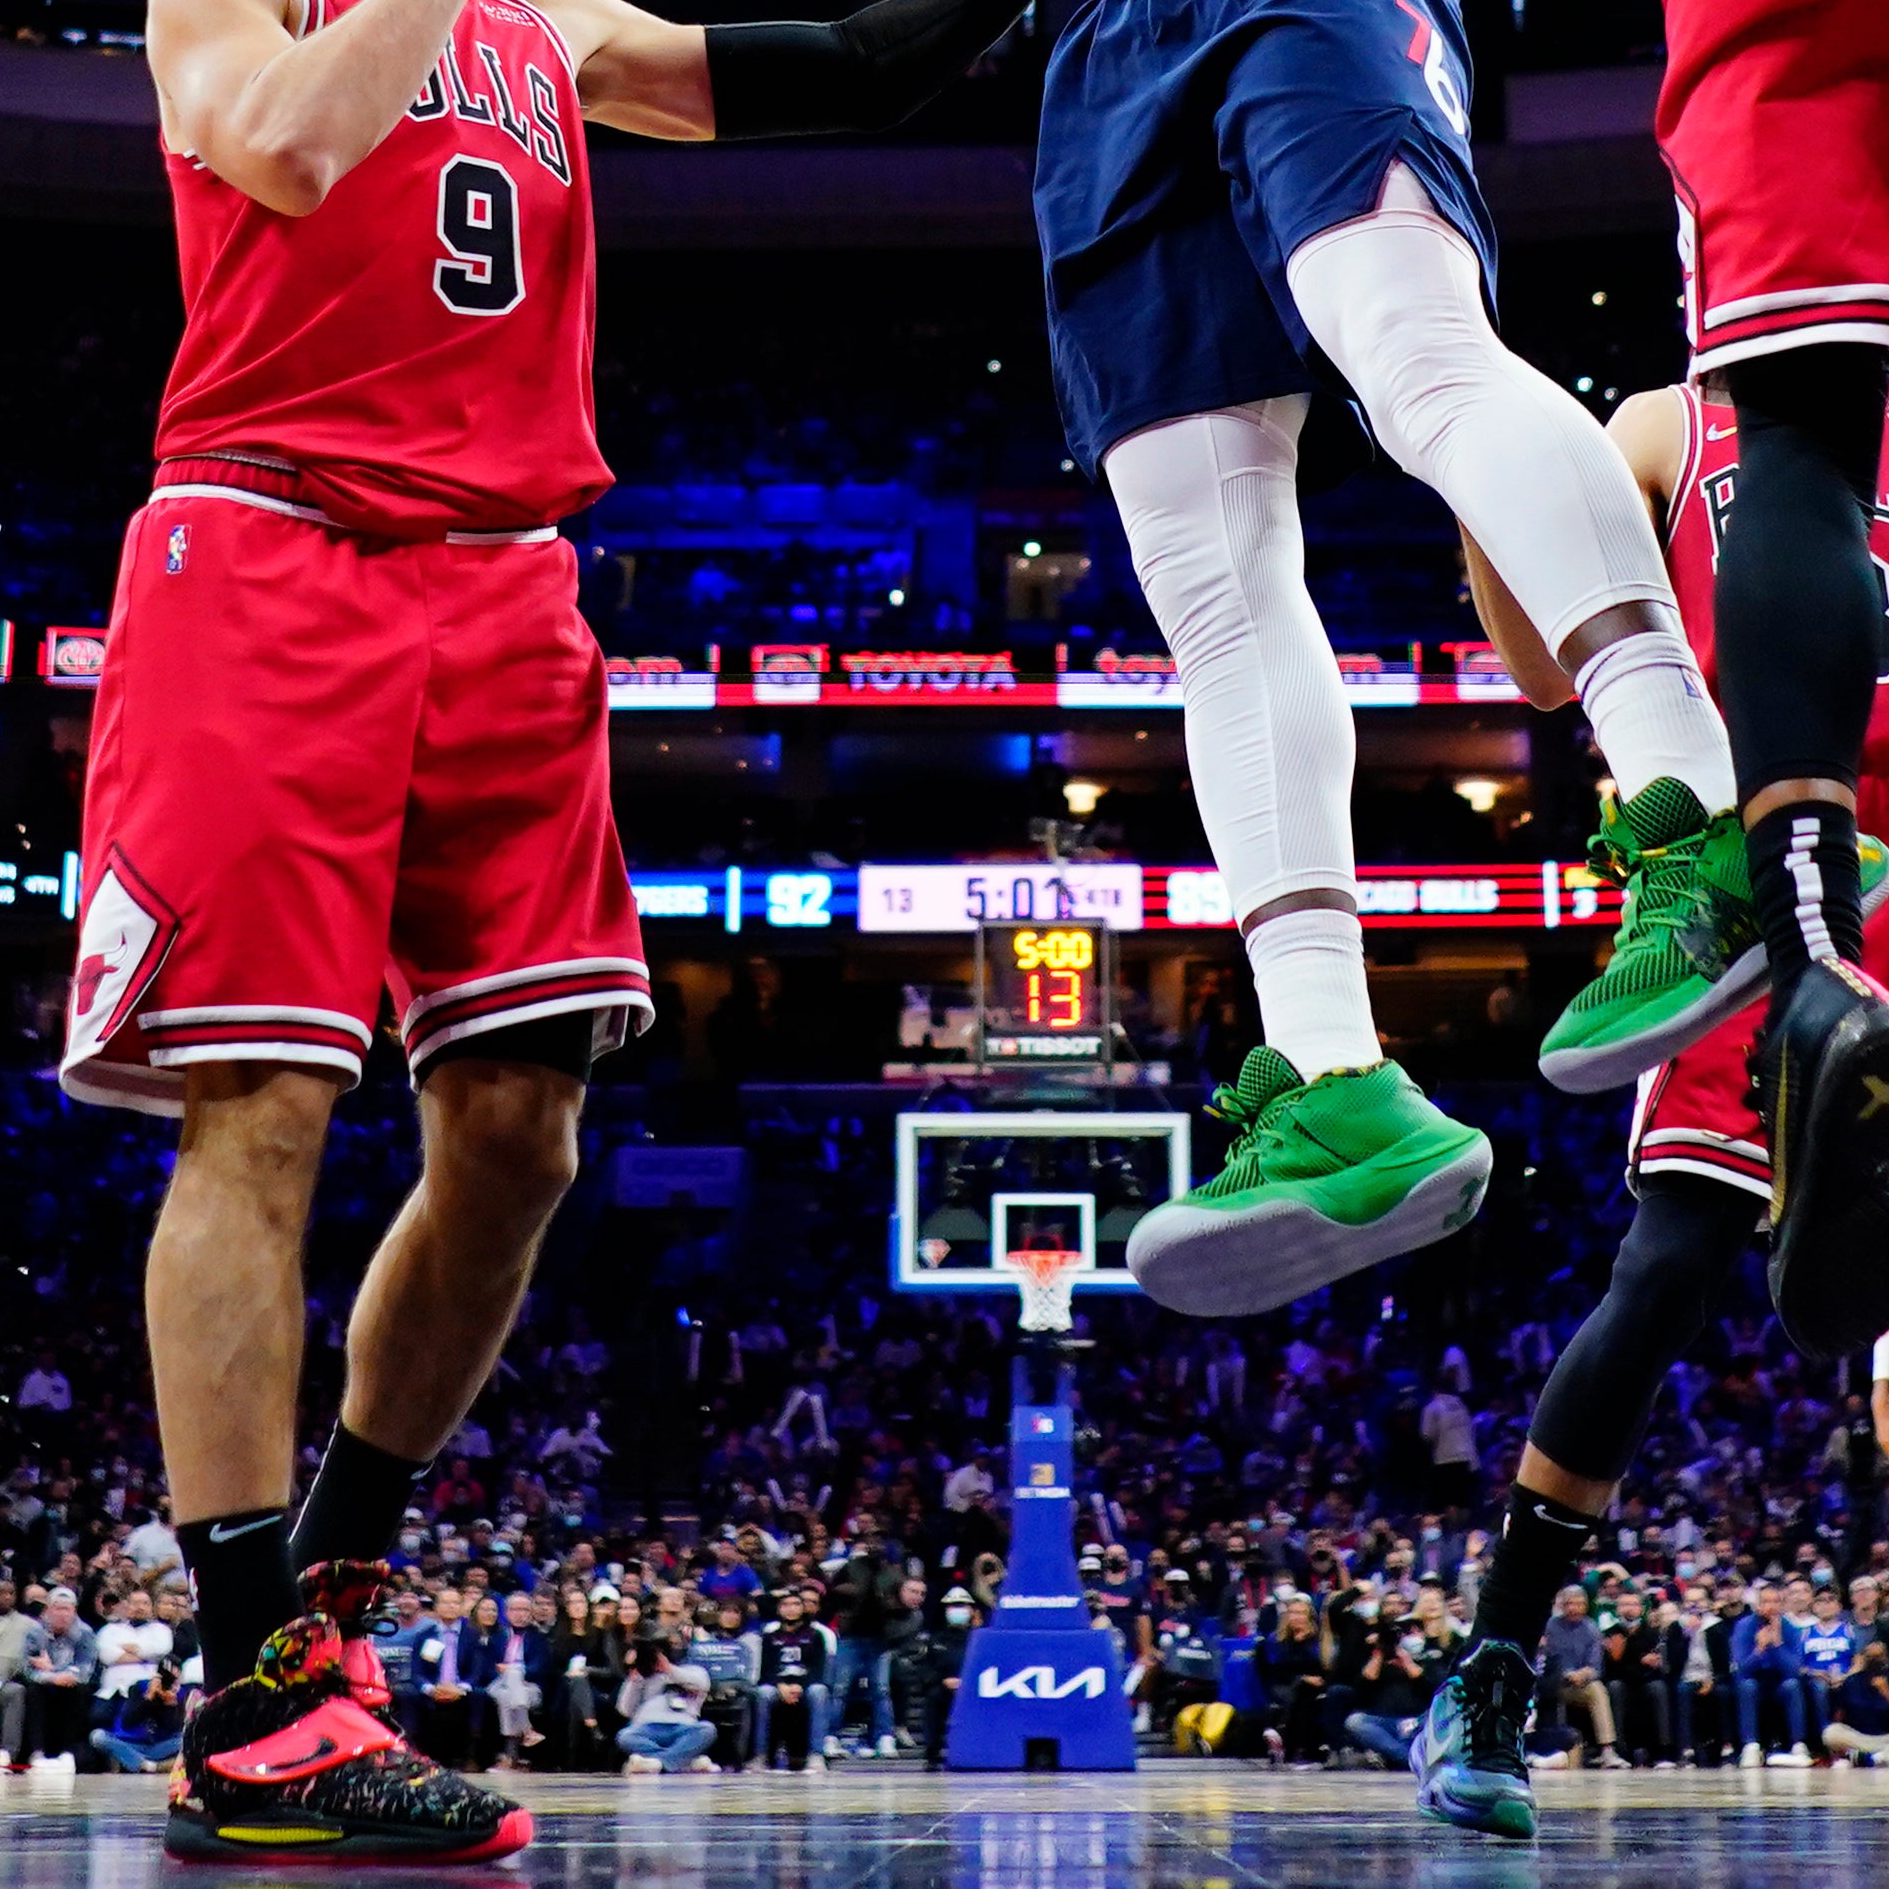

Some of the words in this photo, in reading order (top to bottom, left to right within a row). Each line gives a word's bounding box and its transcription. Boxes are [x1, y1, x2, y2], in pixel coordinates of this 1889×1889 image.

[405, 34, 570, 185] ULLS
[432, 152, 526, 316] 9
[839, 650, 1019, 692] TOYOTA
[767, 873, 832, 926] 92
[882, 888, 913, 913] 13
[1013, 931, 1092, 970] 5:00
[1028, 970, 1081, 1030] 13
[1020, 1037, 1102, 1055] TISSOT
[978, 1666, 1106, 1700] KIA
